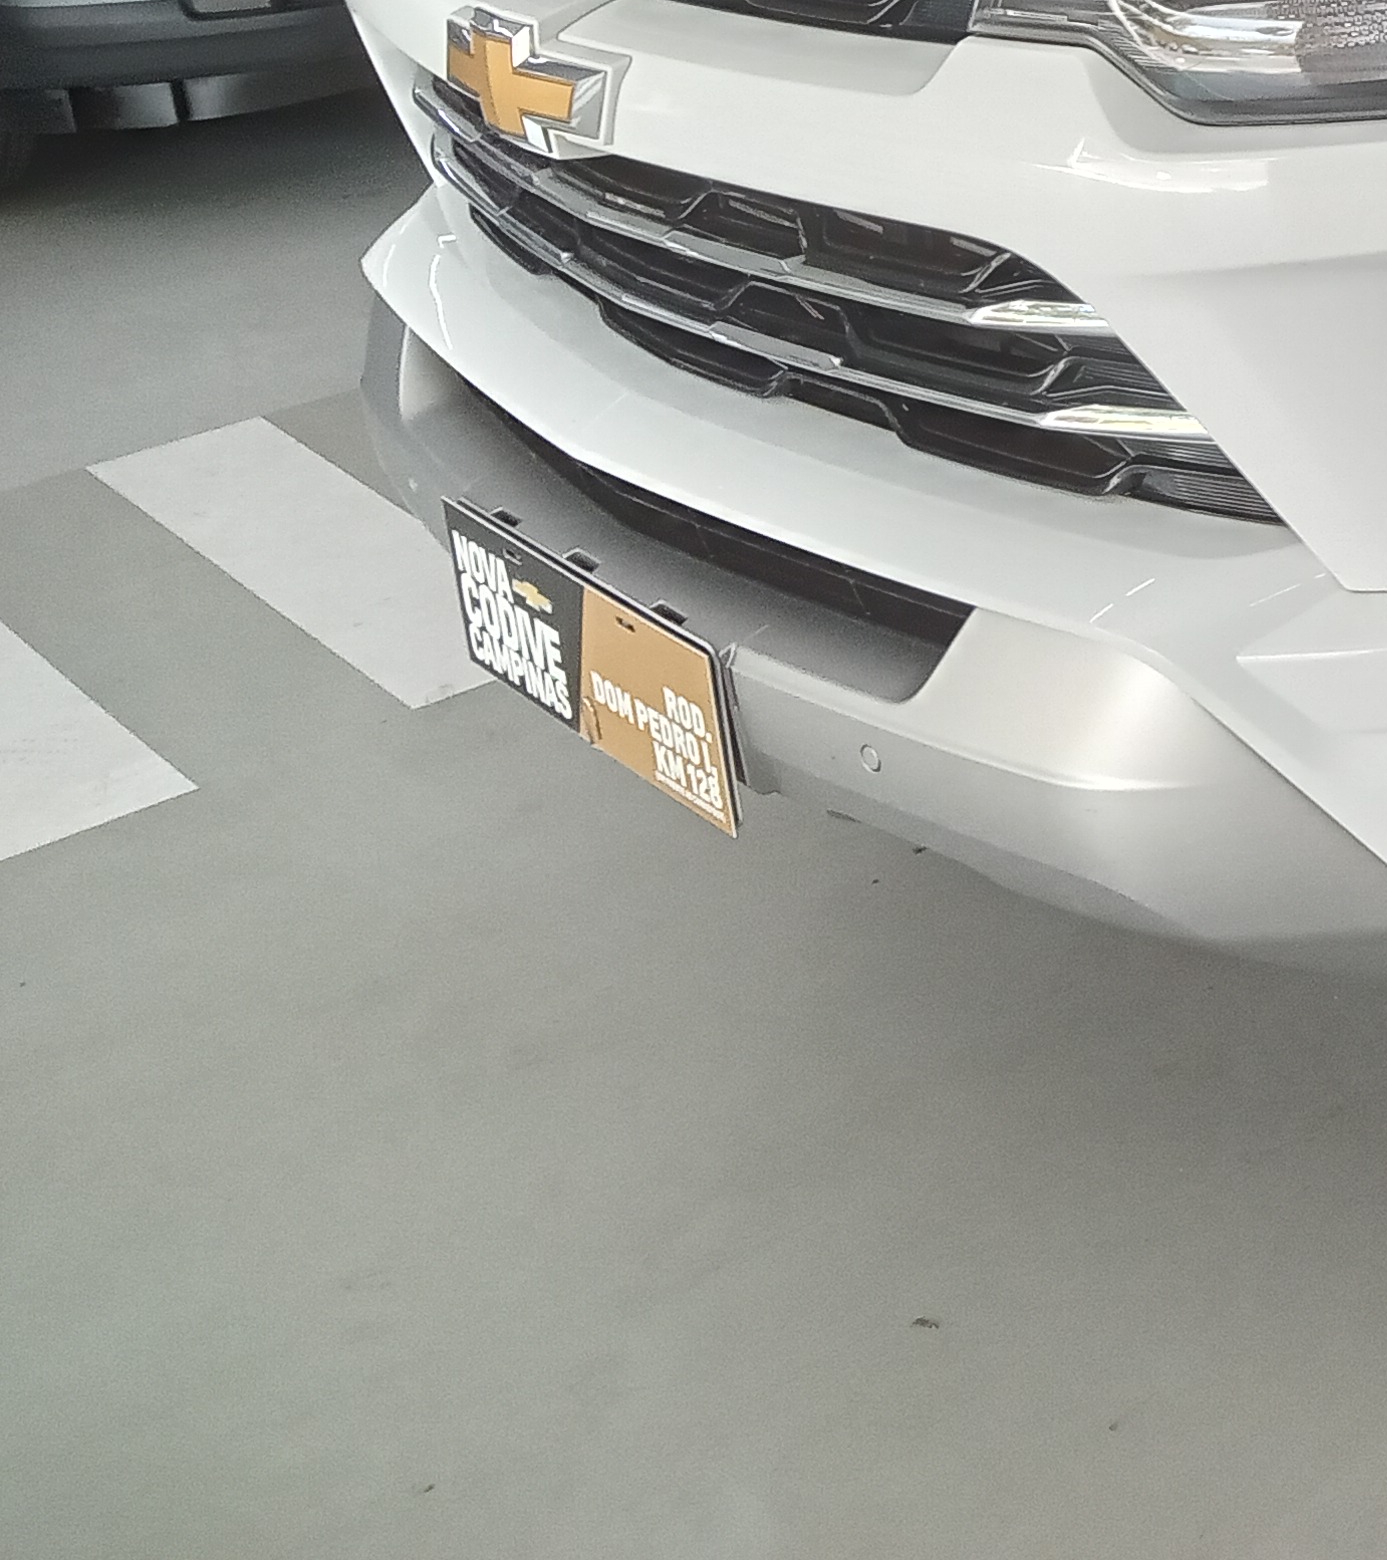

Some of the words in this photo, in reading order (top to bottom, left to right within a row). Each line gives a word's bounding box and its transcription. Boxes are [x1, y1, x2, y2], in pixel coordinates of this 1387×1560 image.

[452, 529, 514, 604] NOVA
[461, 572, 567, 685] CODIVE
[469, 623, 573, 719] CAMPINAS
[590, 670, 635, 724] DOM
[634, 698, 701, 765] PEDRO
[662, 686, 713, 743] ROD.
[652, 741, 687, 787] KM
[686, 763, 724, 809] 128
